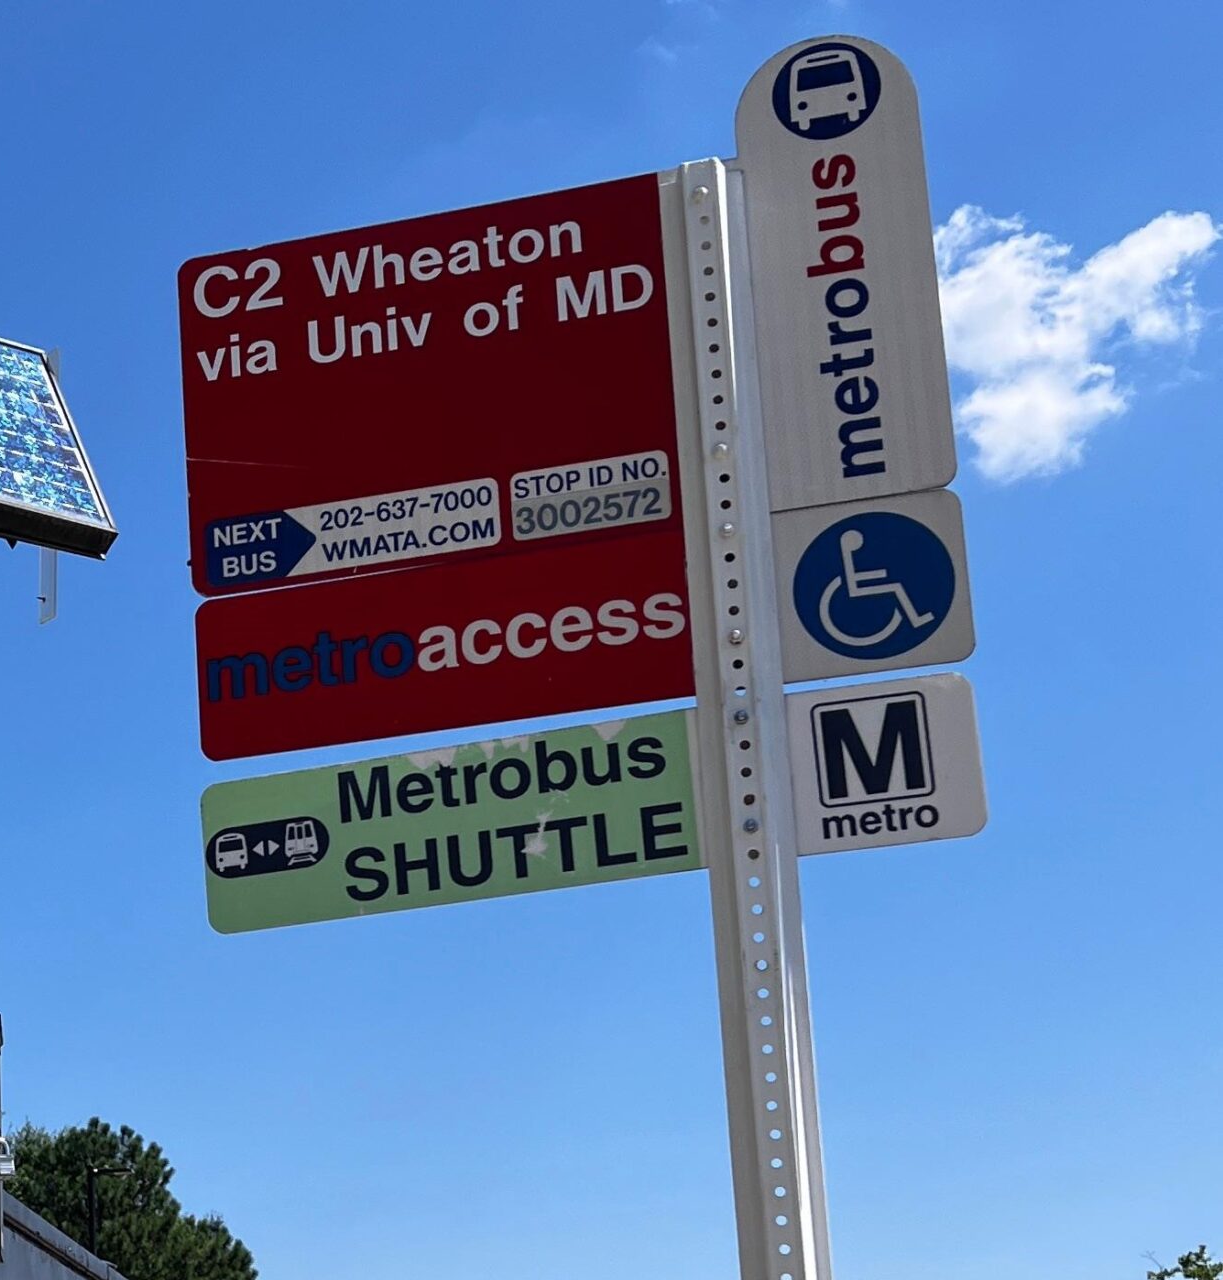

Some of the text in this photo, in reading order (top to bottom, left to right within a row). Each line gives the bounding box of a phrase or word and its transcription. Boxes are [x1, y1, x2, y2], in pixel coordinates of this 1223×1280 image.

[193, 221, 582, 318] C2 Wheaton
[197, 264, 654, 381] via Univ of MD
[807, 153, 885, 478] metrobus
[320, 486, 492, 532] 202-637-7000
[514, 458, 667, 499] STOP ID NO.
[516, 487, 662, 535] 3002572
[213, 518, 281, 548] NEXT
[222, 553, 277, 578] BUS
[322, 518, 495, 562] WMATA.COM
[206, 593, 685, 701] metroaccess
[338, 736, 665, 822] Metrobus
[820, 700, 926, 800] M
[344, 802, 688, 901] SHUTTLE
[822, 804, 939, 839] metro
